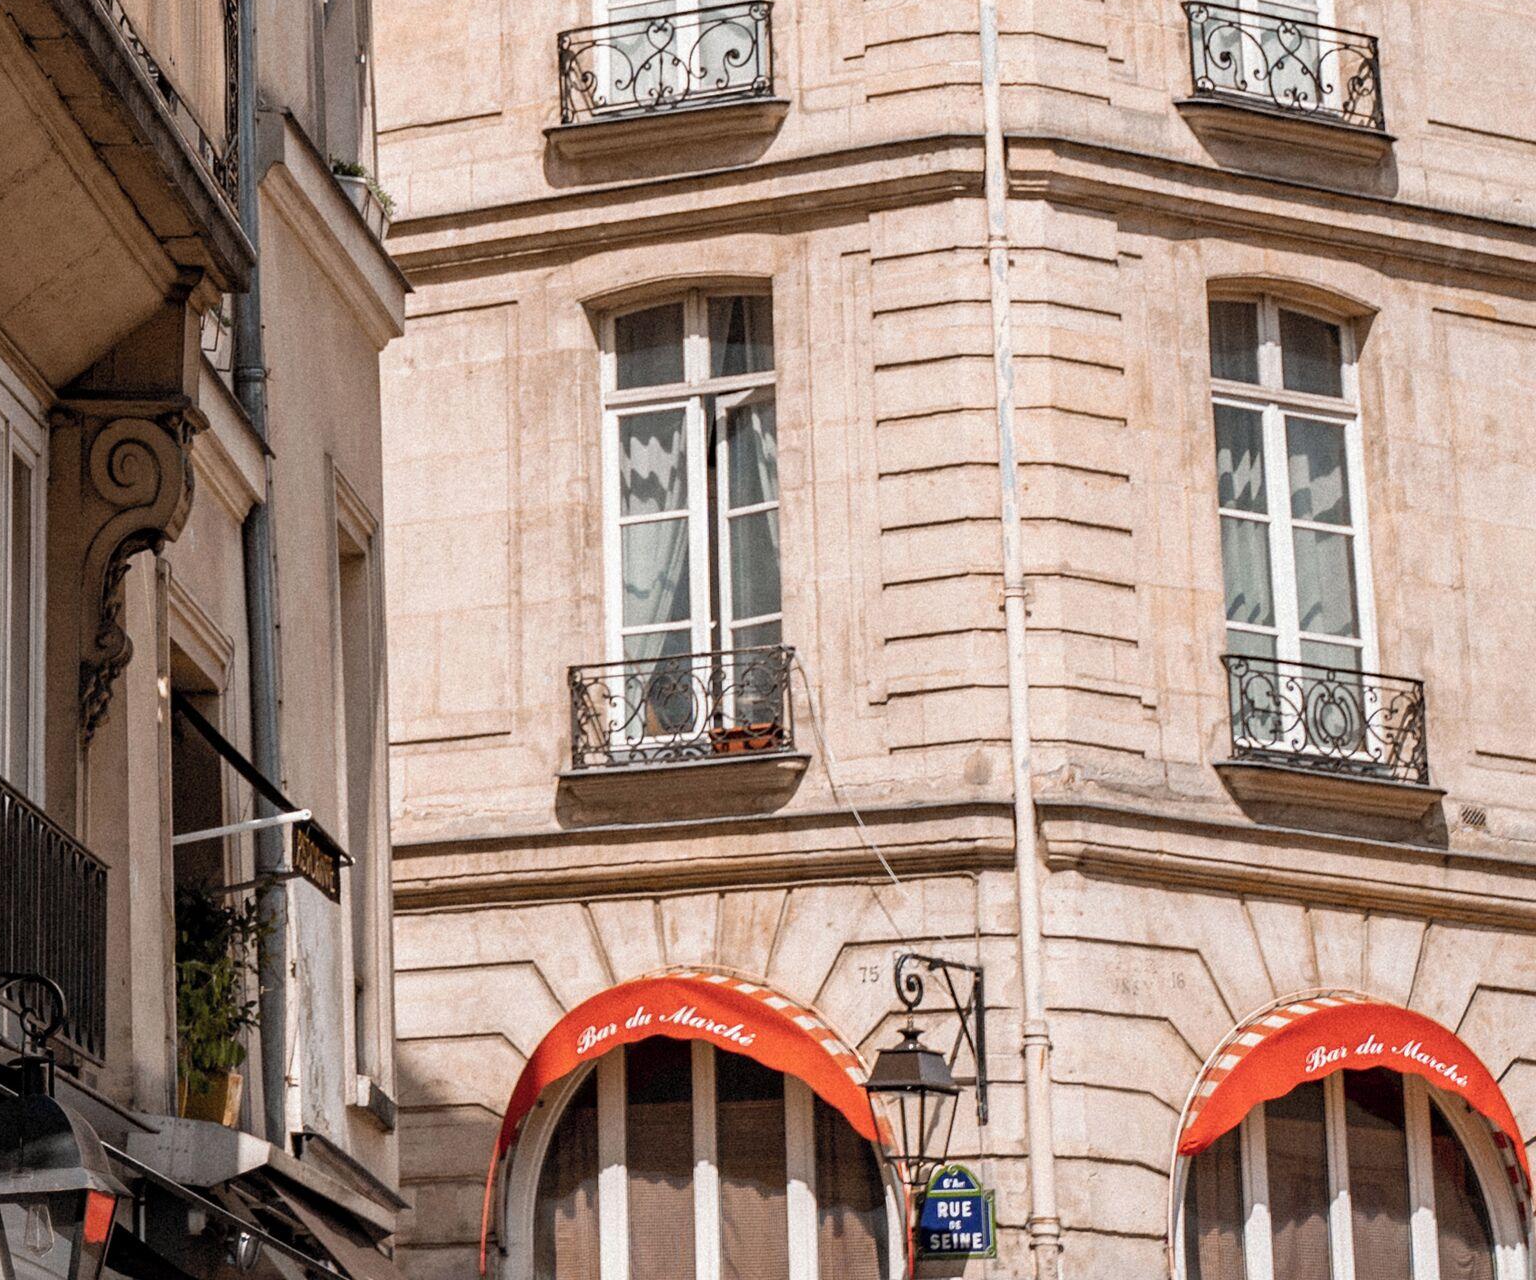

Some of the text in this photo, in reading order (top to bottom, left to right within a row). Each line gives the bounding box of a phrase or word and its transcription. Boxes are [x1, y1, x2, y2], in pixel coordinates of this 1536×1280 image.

[576, 1004, 757, 1055] Bar du Marché
[1305, 1033, 1469, 1088] Bar du Marché
[936, 1200, 973, 1219] RUE
[948, 1219, 962, 1231] DE
[929, 1232, 983, 1250] SEINE
